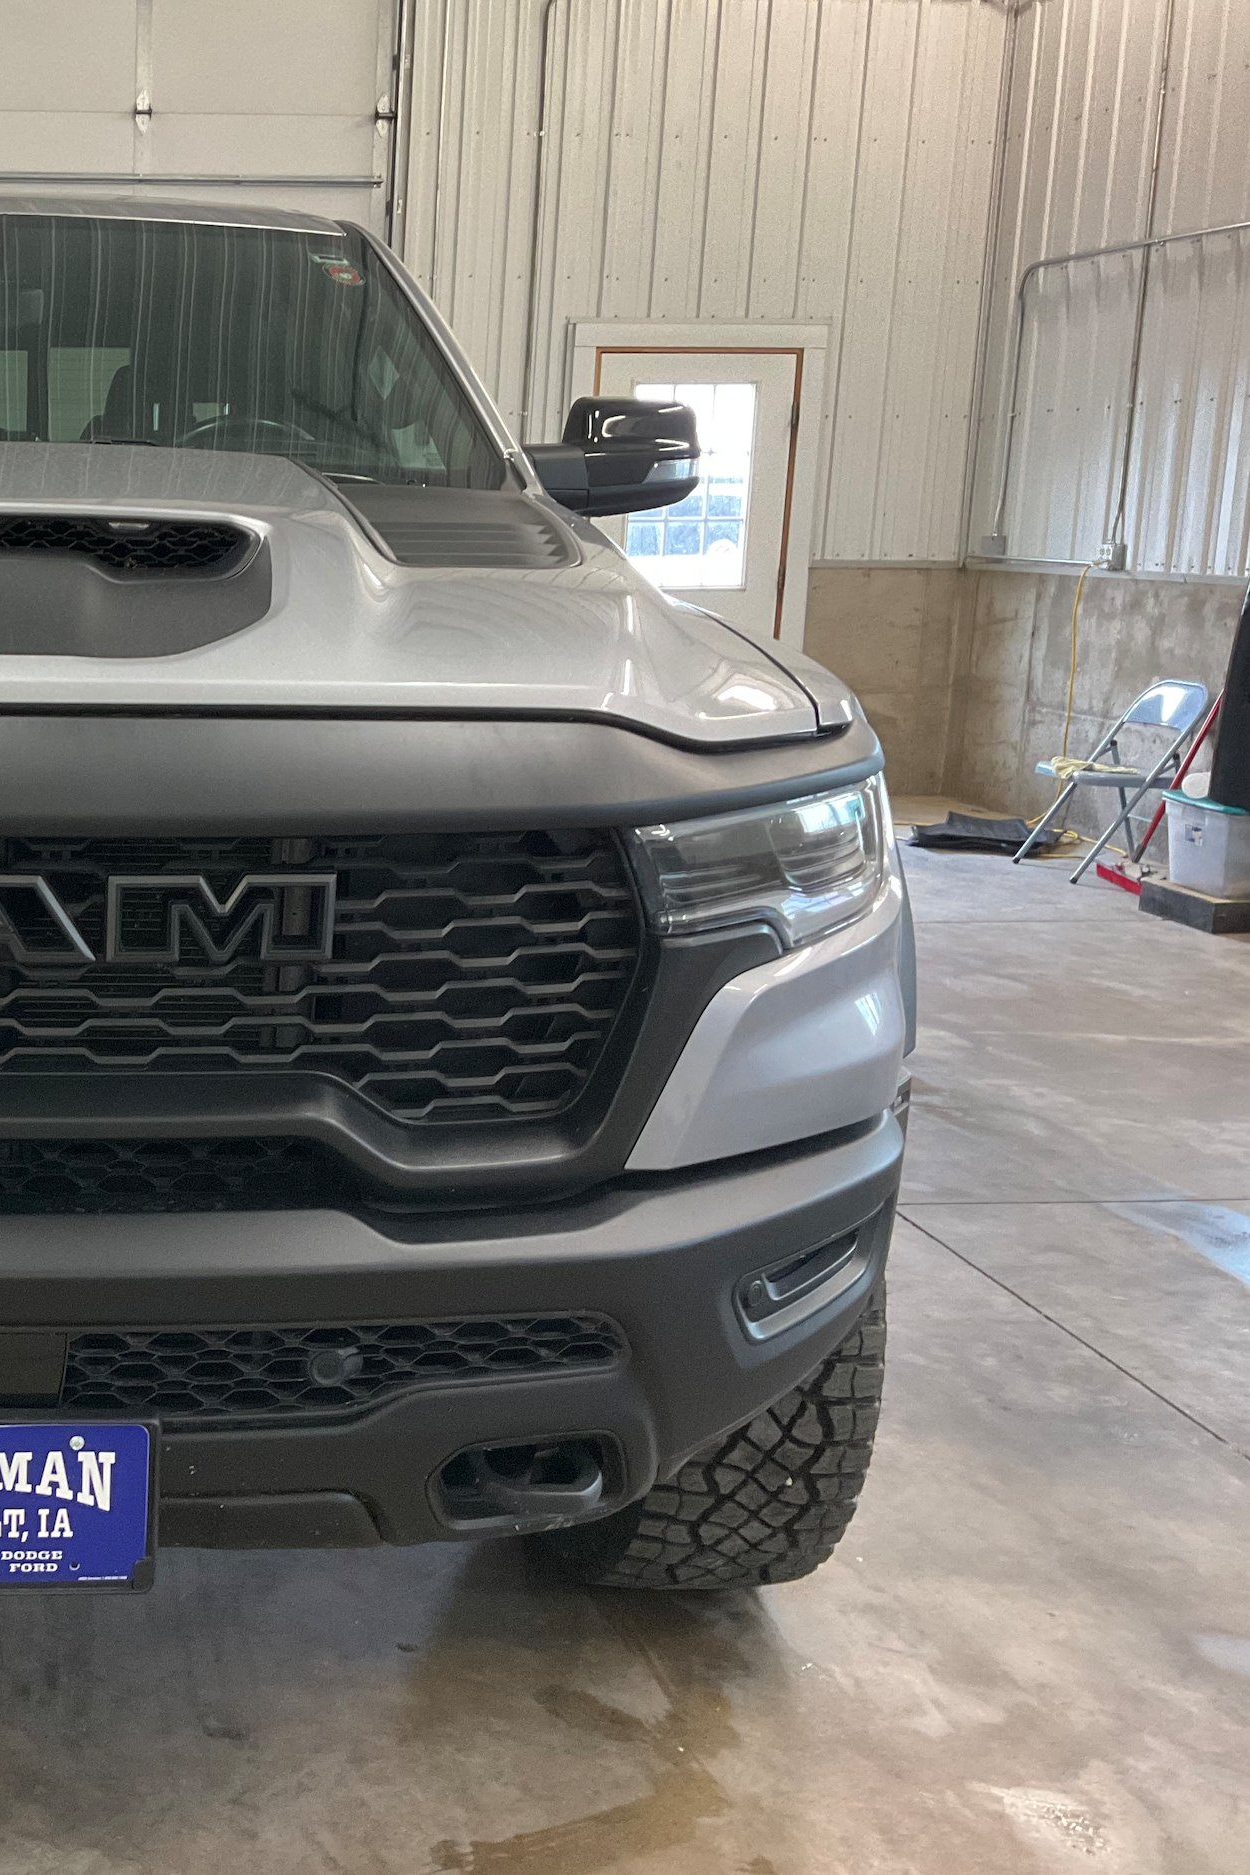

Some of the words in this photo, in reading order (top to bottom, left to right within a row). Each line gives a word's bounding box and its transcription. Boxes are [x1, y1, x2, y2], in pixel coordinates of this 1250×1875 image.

[37, 1508, 73, 1538] IA
[1, 1550, 63, 1560] DODGE
[9, 1563, 58, 1573] FORD
